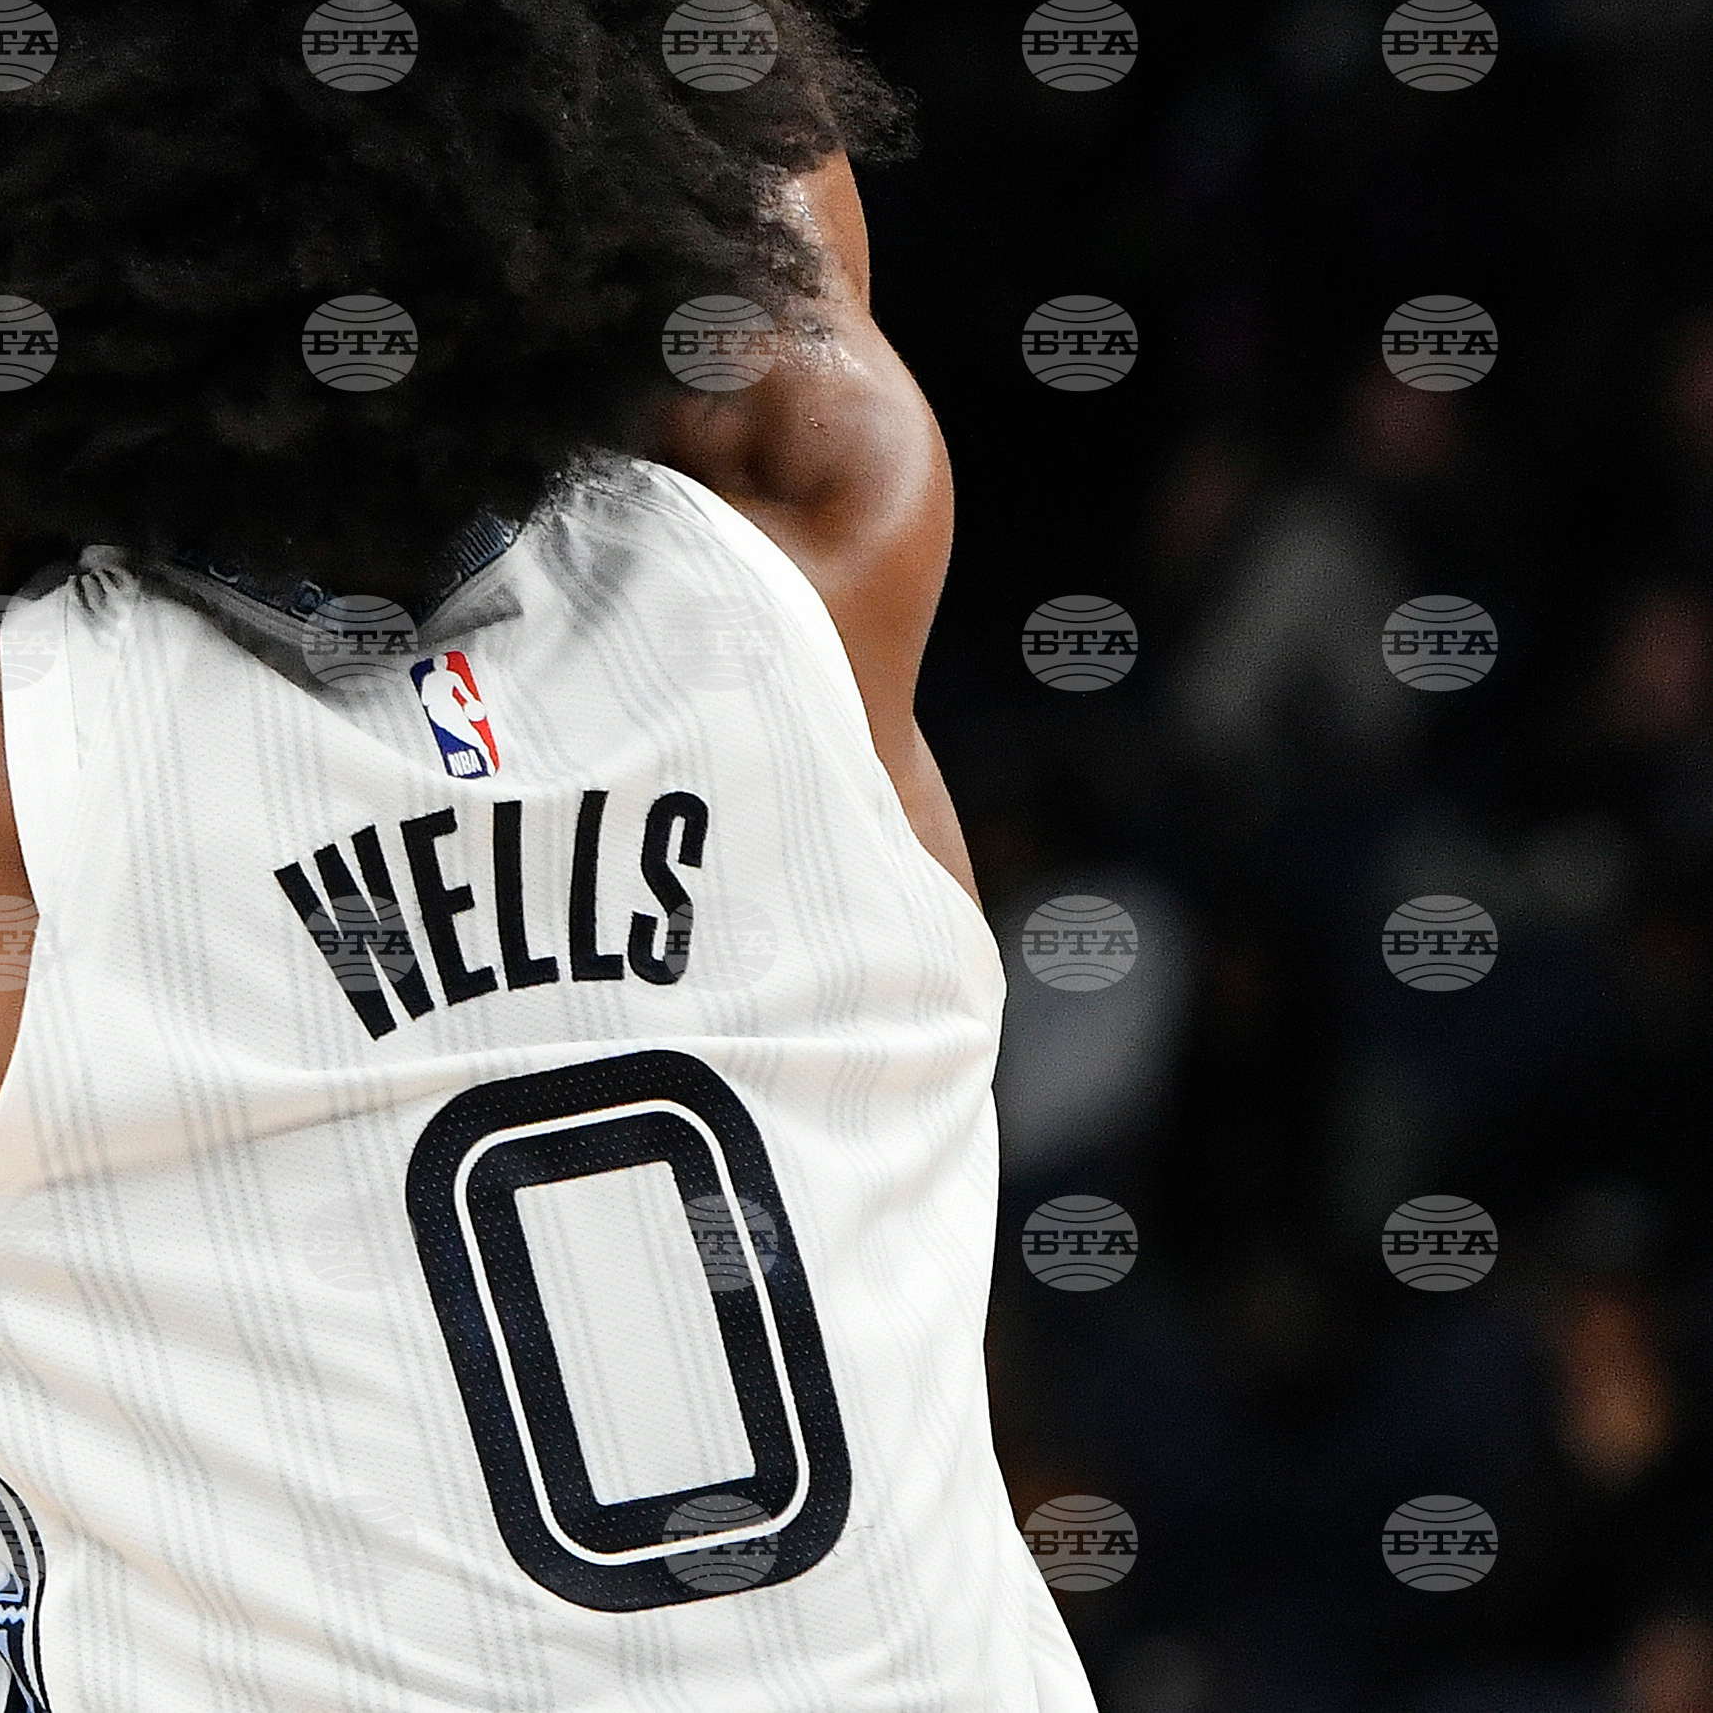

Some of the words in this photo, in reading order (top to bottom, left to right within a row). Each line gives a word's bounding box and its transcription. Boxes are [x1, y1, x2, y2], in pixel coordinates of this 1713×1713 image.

[447, 748, 483, 776] NBA
[273, 789, 710, 1041] WELLS
[405, 1049, 852, 1614] 0
